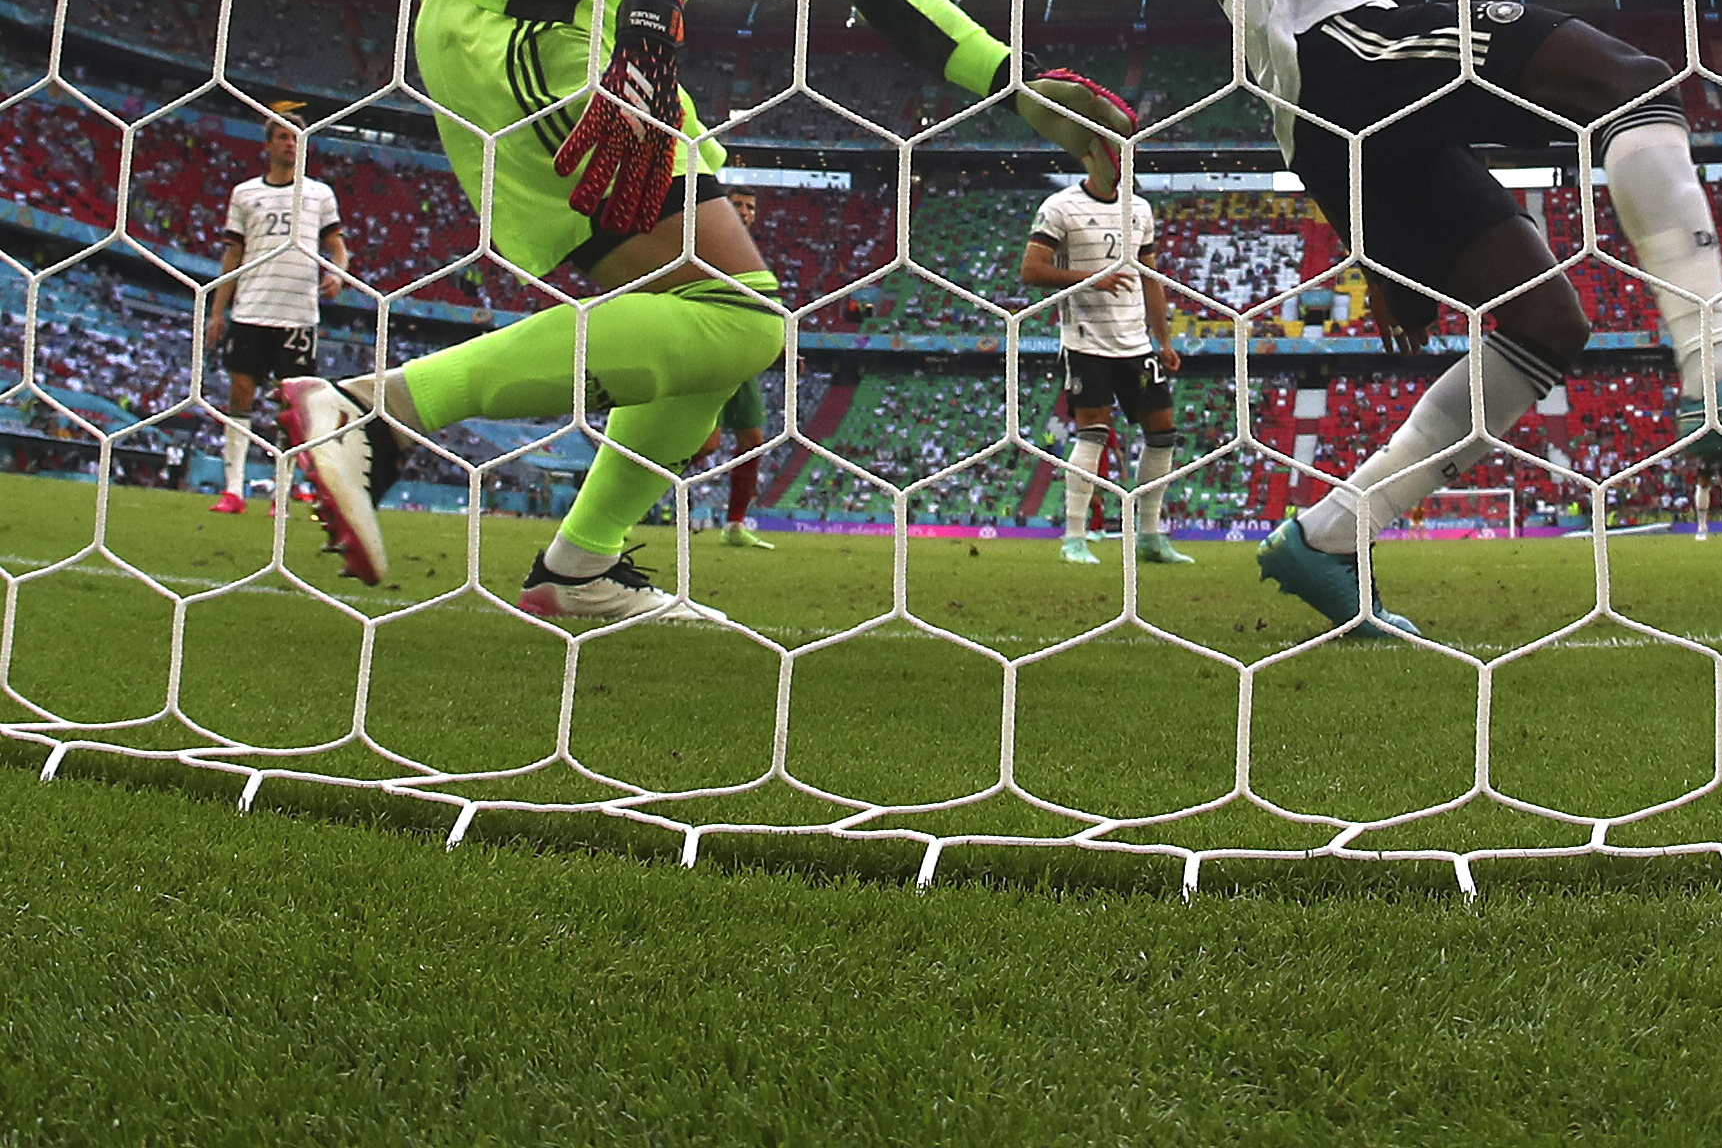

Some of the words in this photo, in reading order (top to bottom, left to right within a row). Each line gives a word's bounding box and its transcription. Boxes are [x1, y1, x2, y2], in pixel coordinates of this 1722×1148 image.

[629, 10, 660, 21] NEUER
[629, 17, 667, 32] MANUEL
[266, 212, 291, 236] 25
[284, 327, 312, 353] 25
